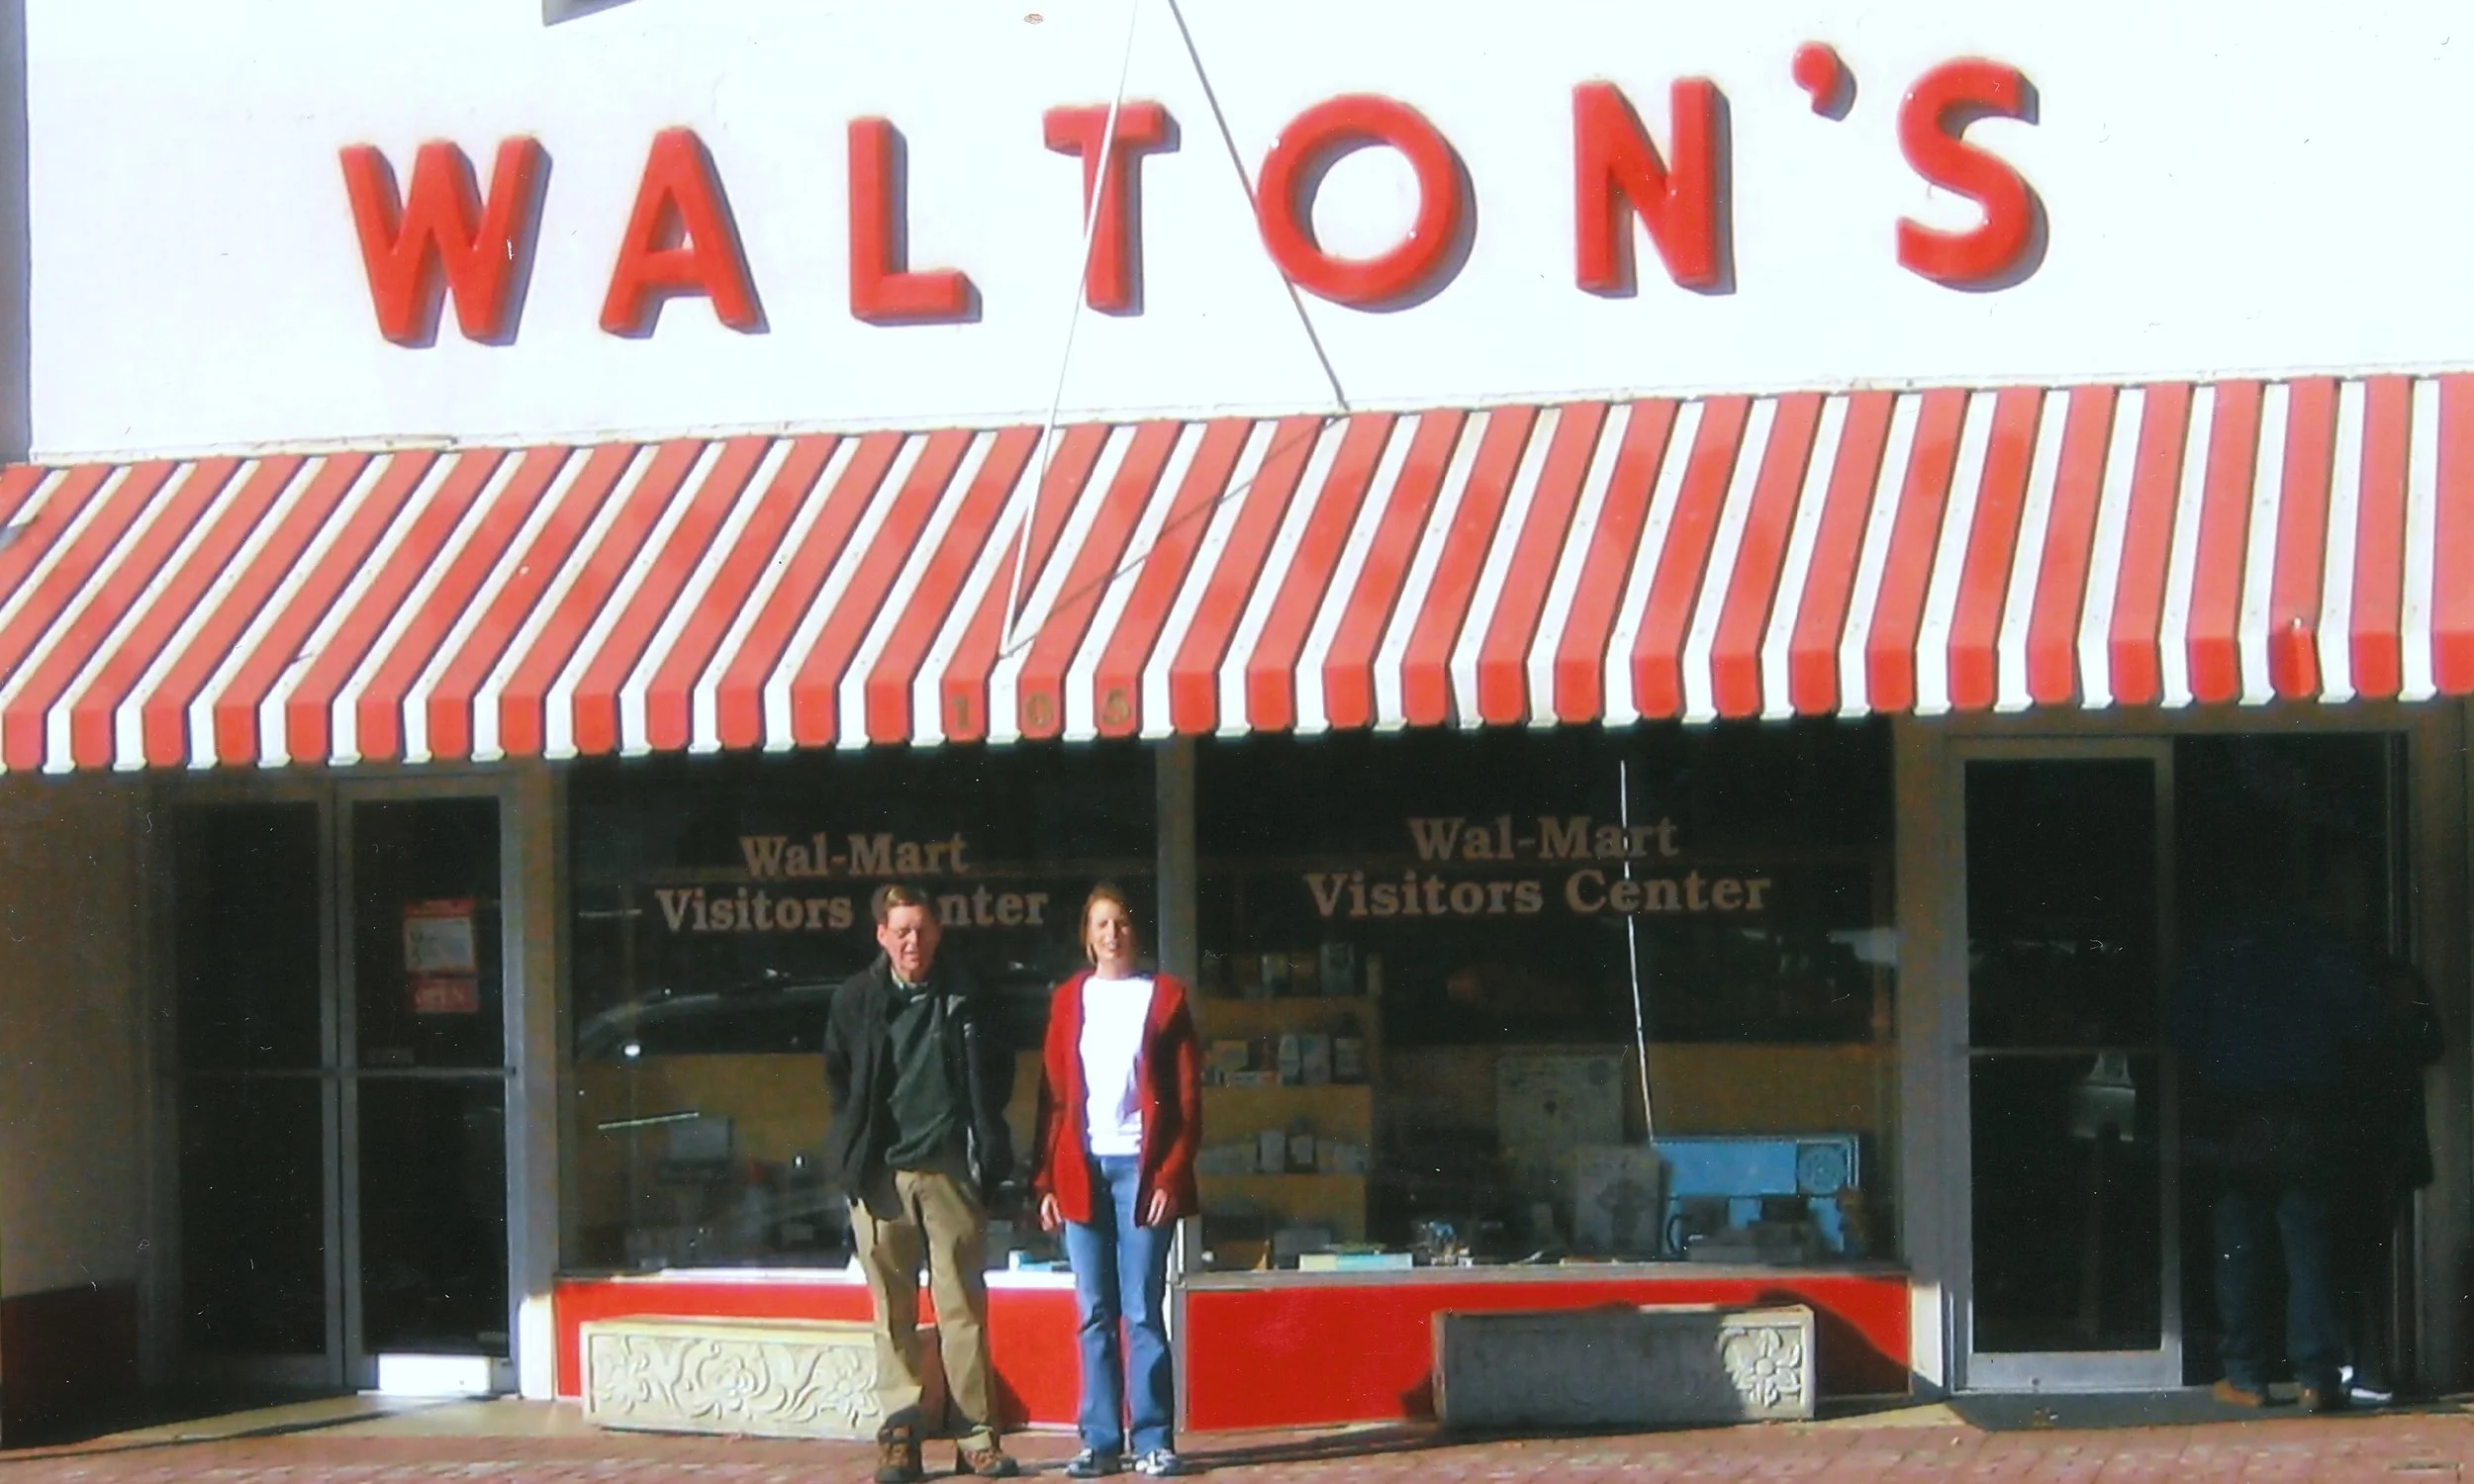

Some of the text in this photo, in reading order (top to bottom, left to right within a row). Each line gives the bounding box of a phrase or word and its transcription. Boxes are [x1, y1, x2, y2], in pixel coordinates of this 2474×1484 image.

[340, 41, 2045, 346] WALTON'S
[739, 833, 968, 878] Wal-Mart
[1406, 814, 1679, 861] Wal-Mart
[654, 883, 1049, 933] Visitors nter
[1304, 870, 1770, 917] Visitors Center
